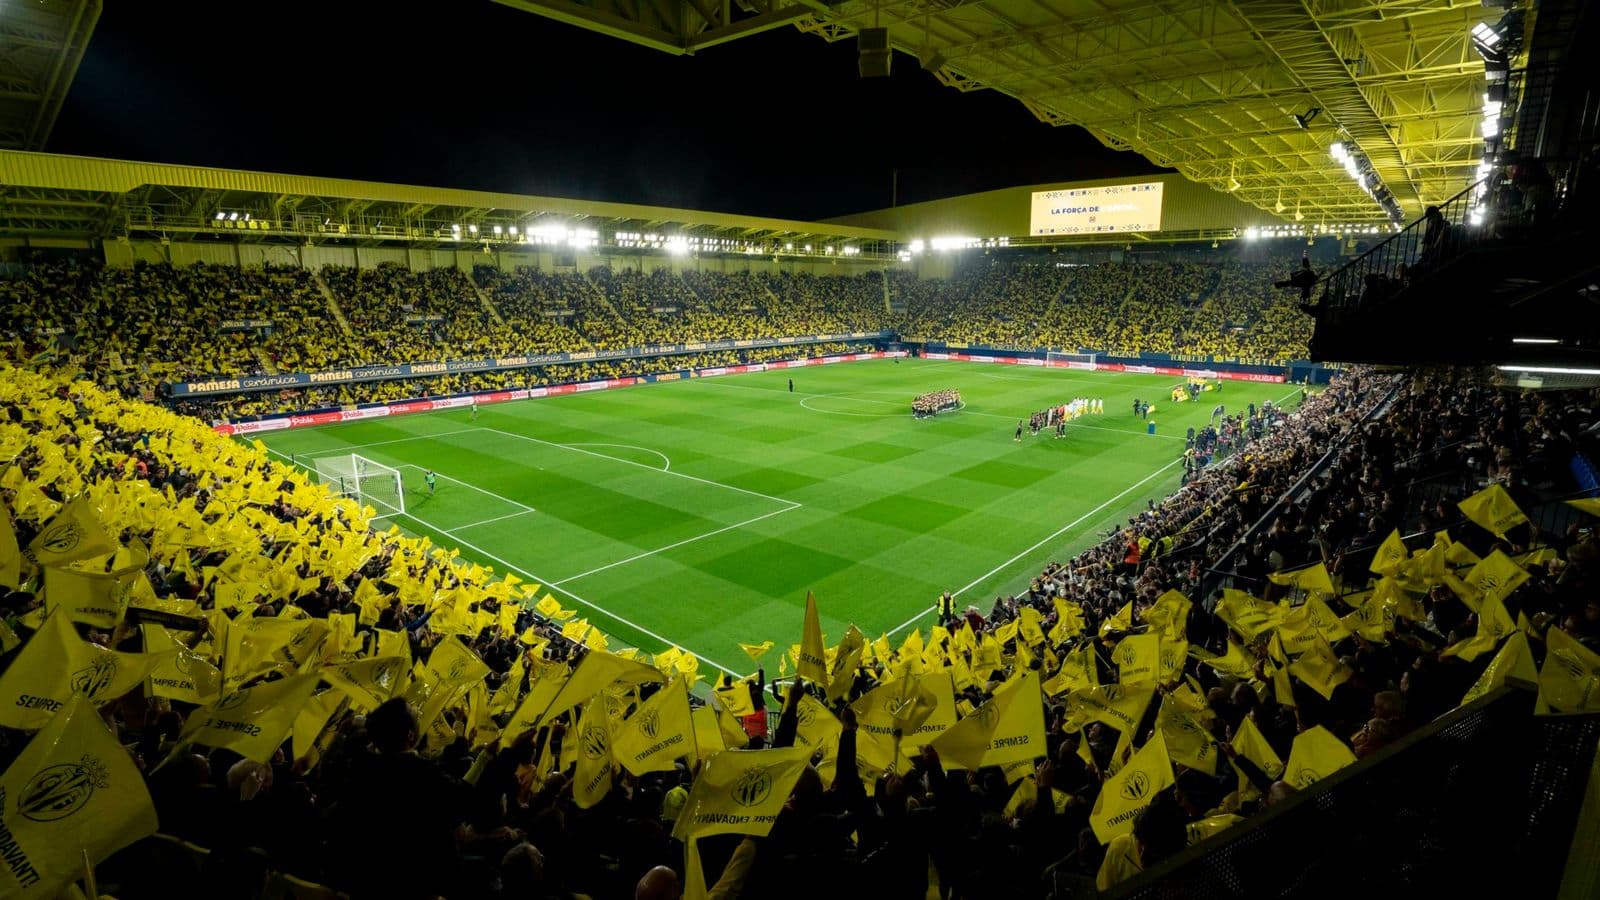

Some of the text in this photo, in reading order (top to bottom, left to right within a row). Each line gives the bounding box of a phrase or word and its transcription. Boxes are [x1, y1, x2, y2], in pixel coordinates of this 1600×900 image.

[411, 363, 447, 374] PAMESA
[310, 370, 353, 382] PAMESA
[188, 380, 240, 393] PAMESA
